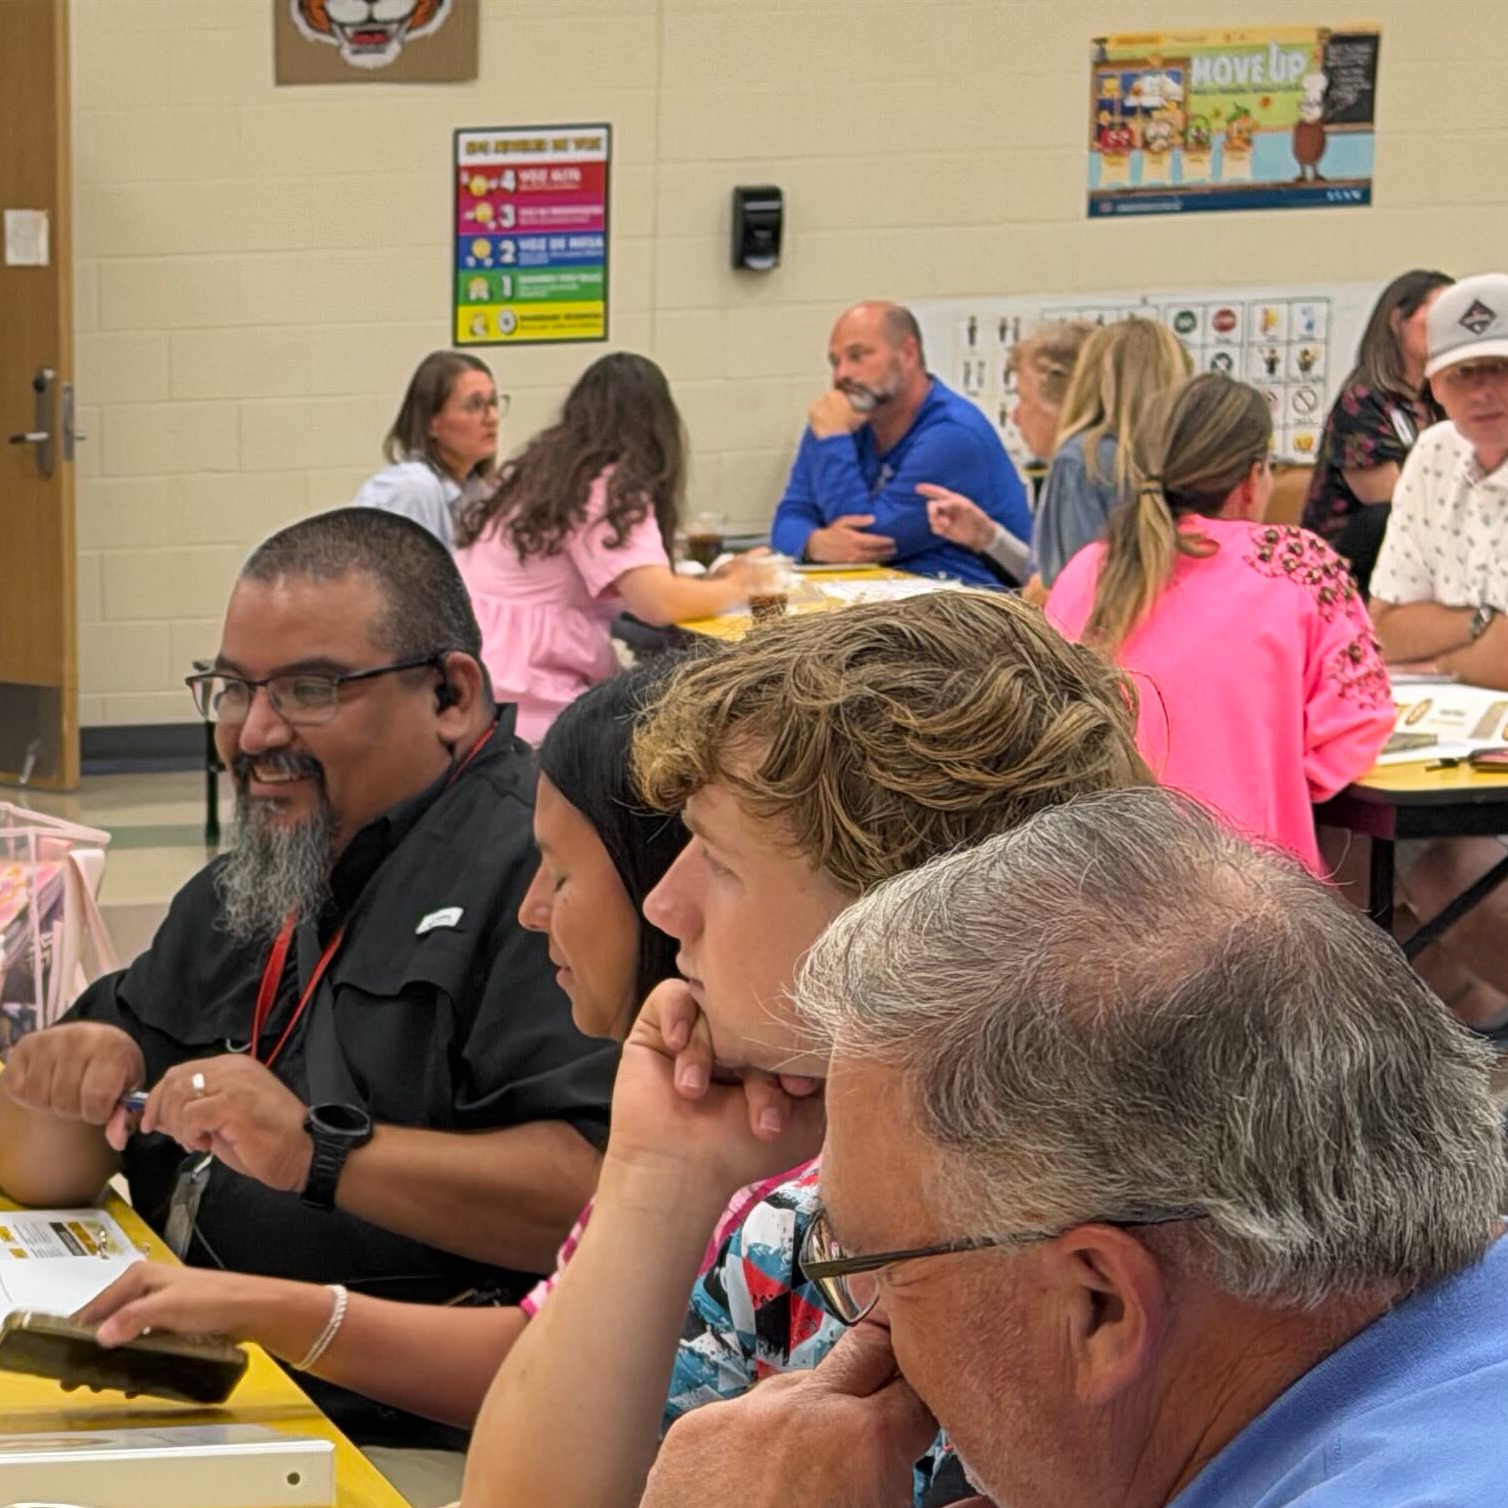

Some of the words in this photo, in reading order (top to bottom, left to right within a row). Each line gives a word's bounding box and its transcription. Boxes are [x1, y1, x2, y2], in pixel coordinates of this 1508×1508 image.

[1190, 54, 1264, 84] MOVE
[500, 169, 516, 192] 4
[500, 204, 516, 228] 3
[500, 240, 516, 264] 2
